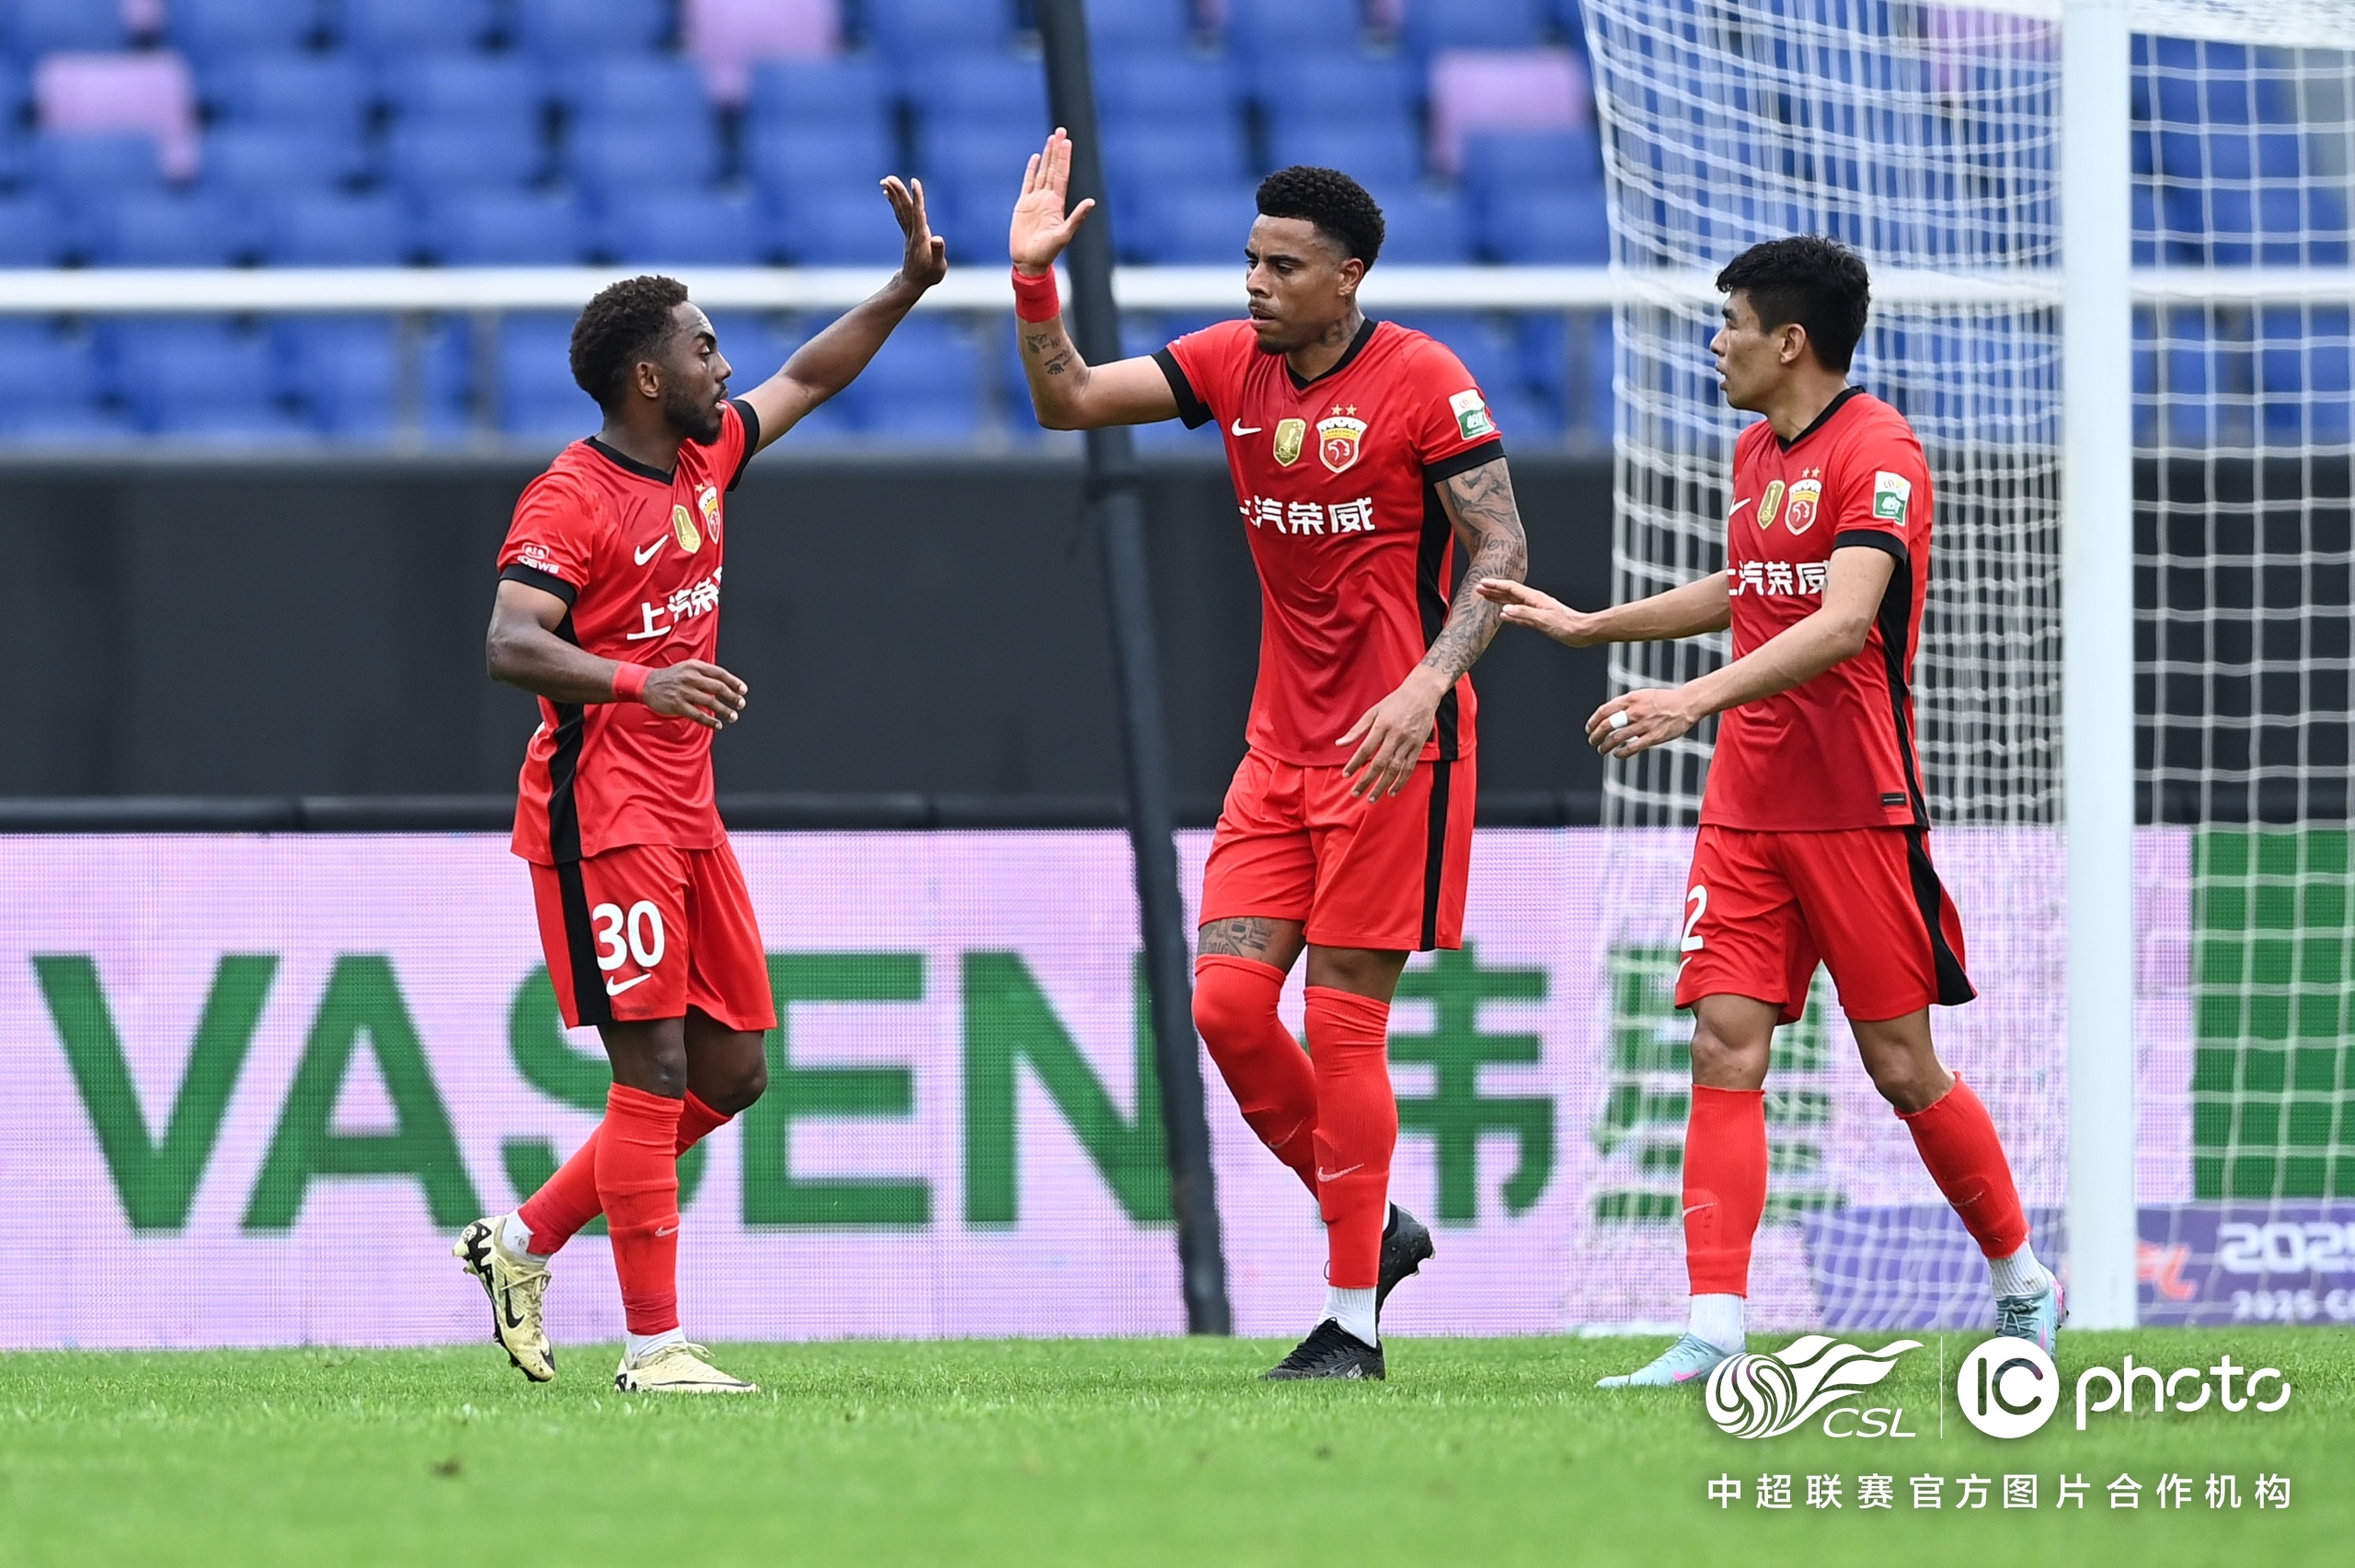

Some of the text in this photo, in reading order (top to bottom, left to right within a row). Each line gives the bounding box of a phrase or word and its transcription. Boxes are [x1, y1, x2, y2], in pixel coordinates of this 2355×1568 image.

[626, 566, 723, 641] 上汽荣
[592, 899, 666, 971] 30
[31, 951, 1174, 1234] VASEN
[2218, 1222, 2355, 1275] 202
